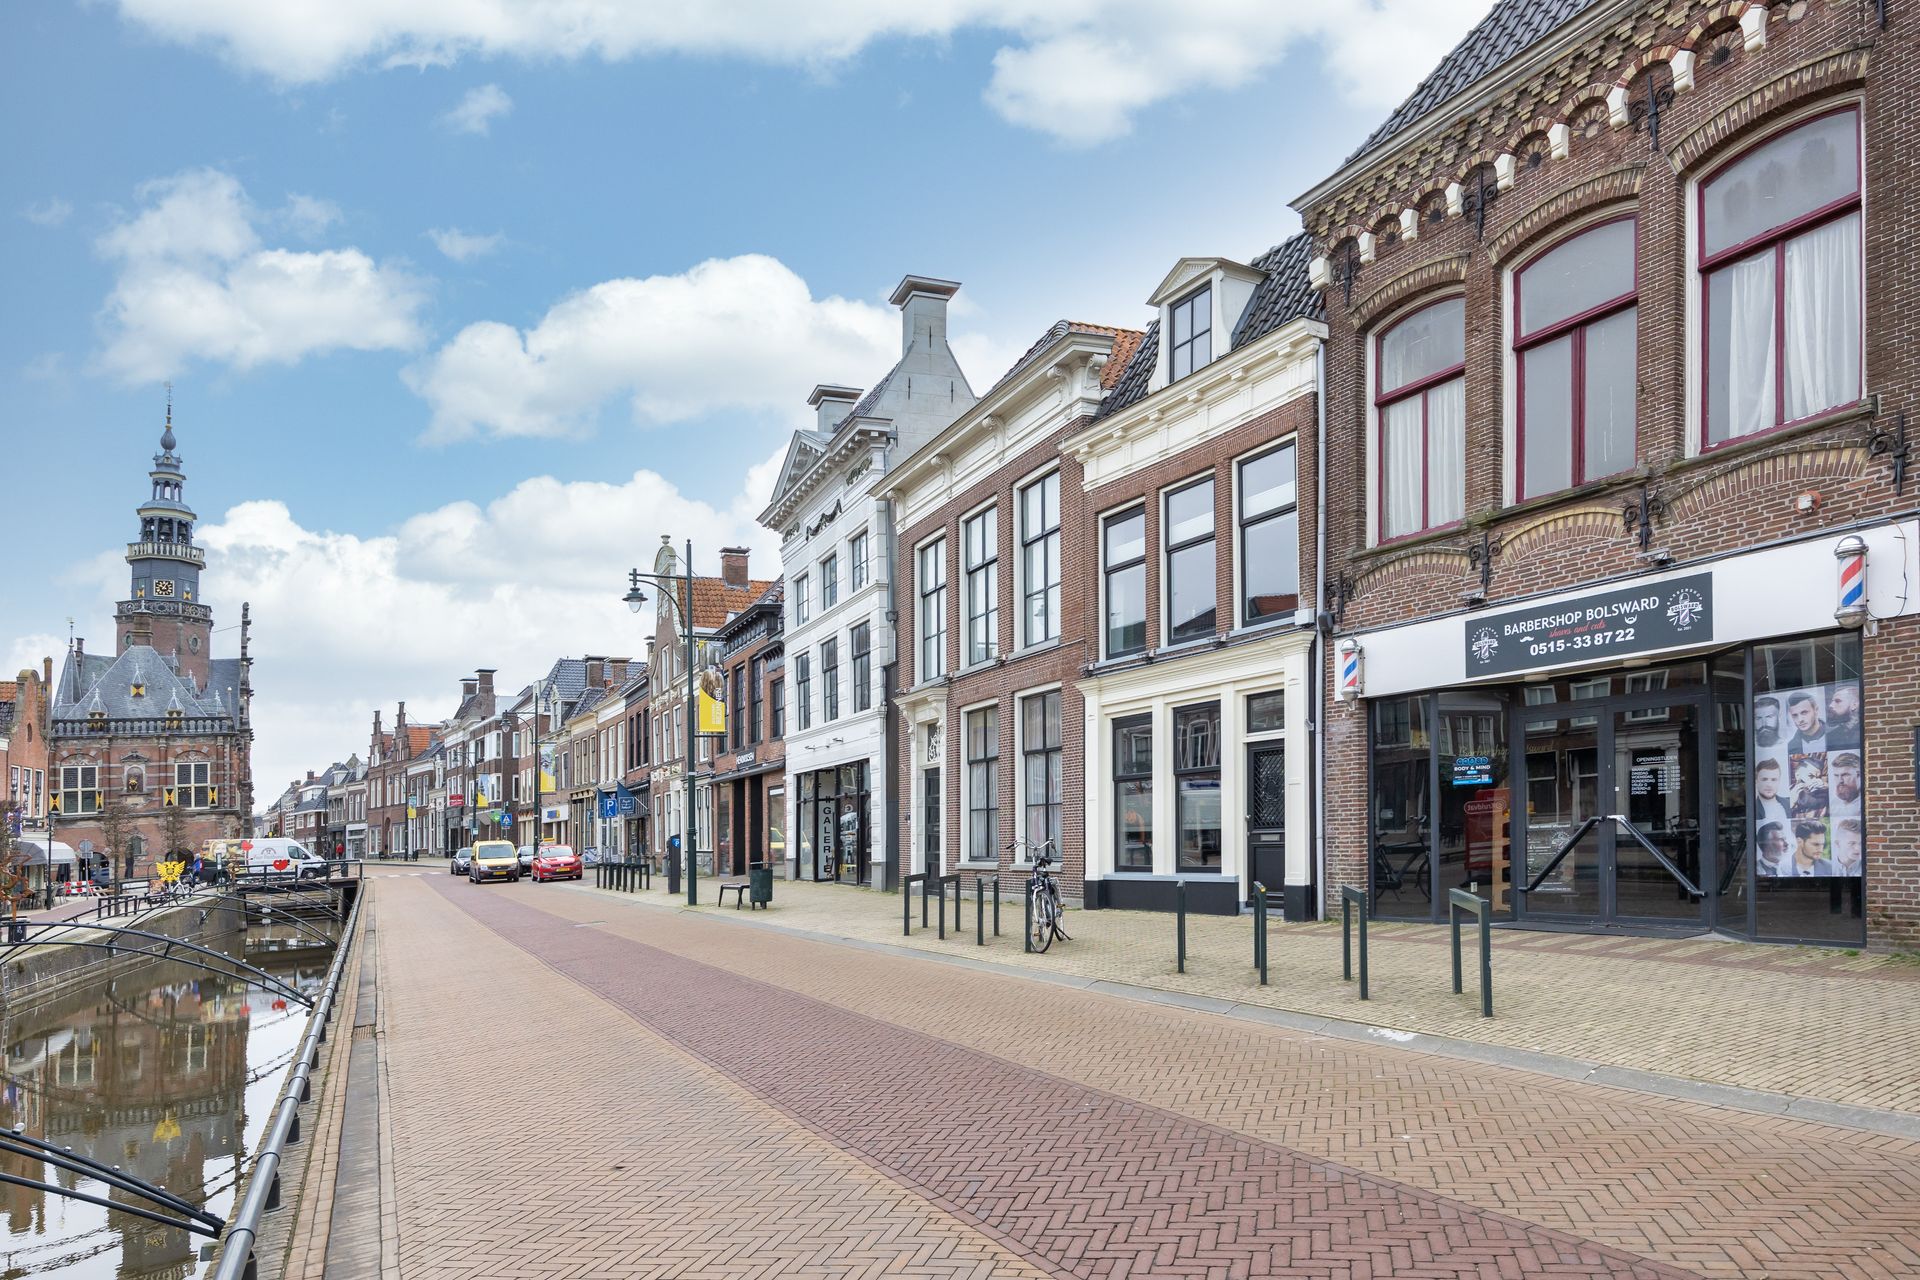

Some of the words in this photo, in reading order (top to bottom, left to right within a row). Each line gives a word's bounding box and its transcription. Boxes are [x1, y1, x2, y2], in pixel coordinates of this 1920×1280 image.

[1504, 611, 1582, 636] BARBERSHOP
[1586, 597, 1659, 621] BOLSWARD
[1671, 603, 1699, 612] BOLSWARD
[1548, 627, 1571, 639] shaves
[1574, 621, 1589, 634] and
[1591, 619, 1606, 631] cuts
[1594, 631, 1613, 646] 87
[1615, 628, 1635, 642] 22
[607, 800, 614, 810] P
[823, 806, 832, 873] GALERIE
